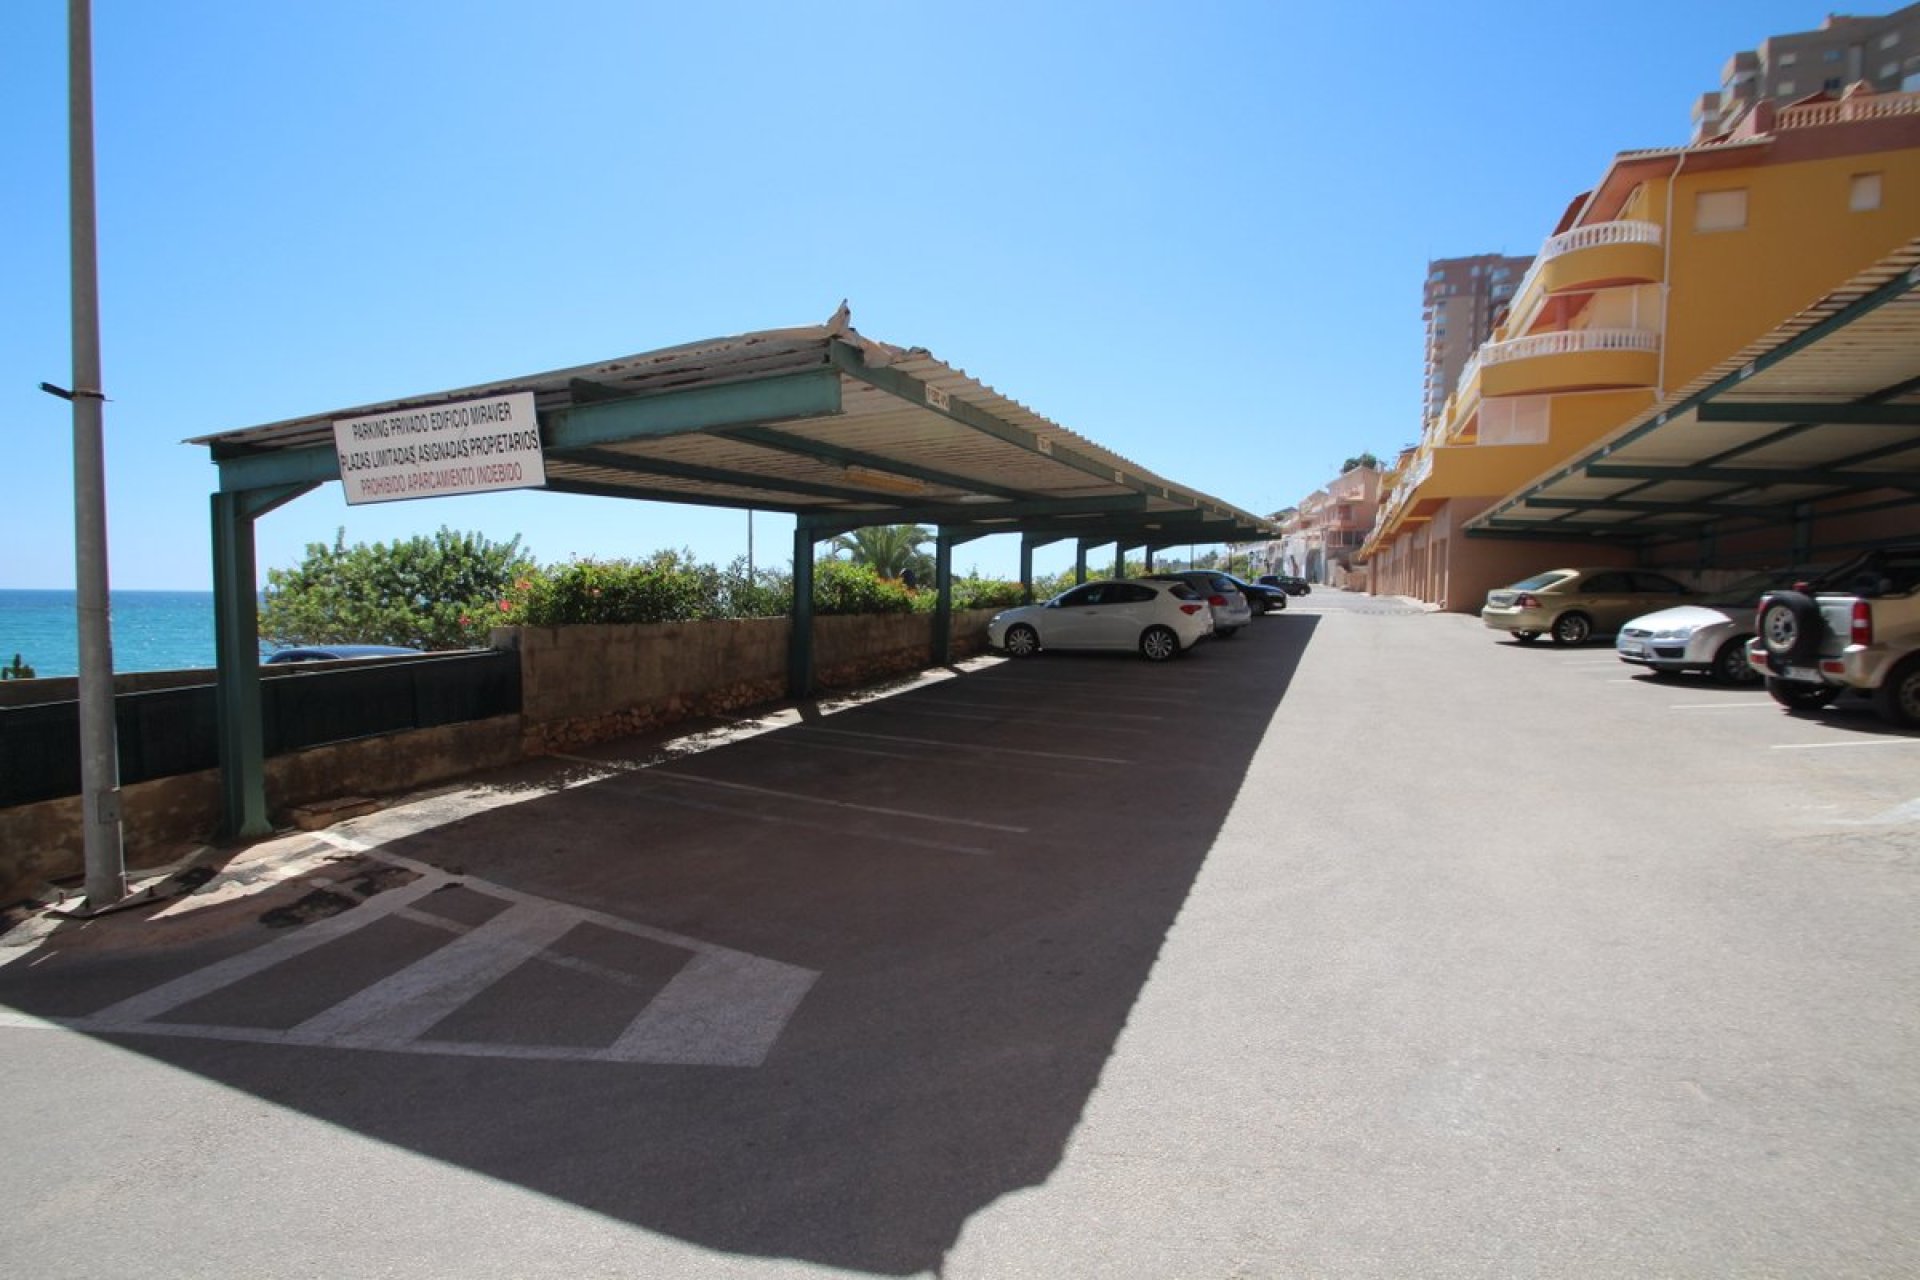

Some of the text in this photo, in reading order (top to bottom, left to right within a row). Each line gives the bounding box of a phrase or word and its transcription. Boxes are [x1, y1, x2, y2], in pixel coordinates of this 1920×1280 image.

[352, 402, 512, 441] PARKING PRIVADO EDIFICIO MIRAVER
[341, 451, 371, 471] PLAZAS
[470, 430, 538, 455] PROPIETARIOS
[360, 462, 523, 496] PROHIBIDO APARCAMIENTO INDEBIDO
